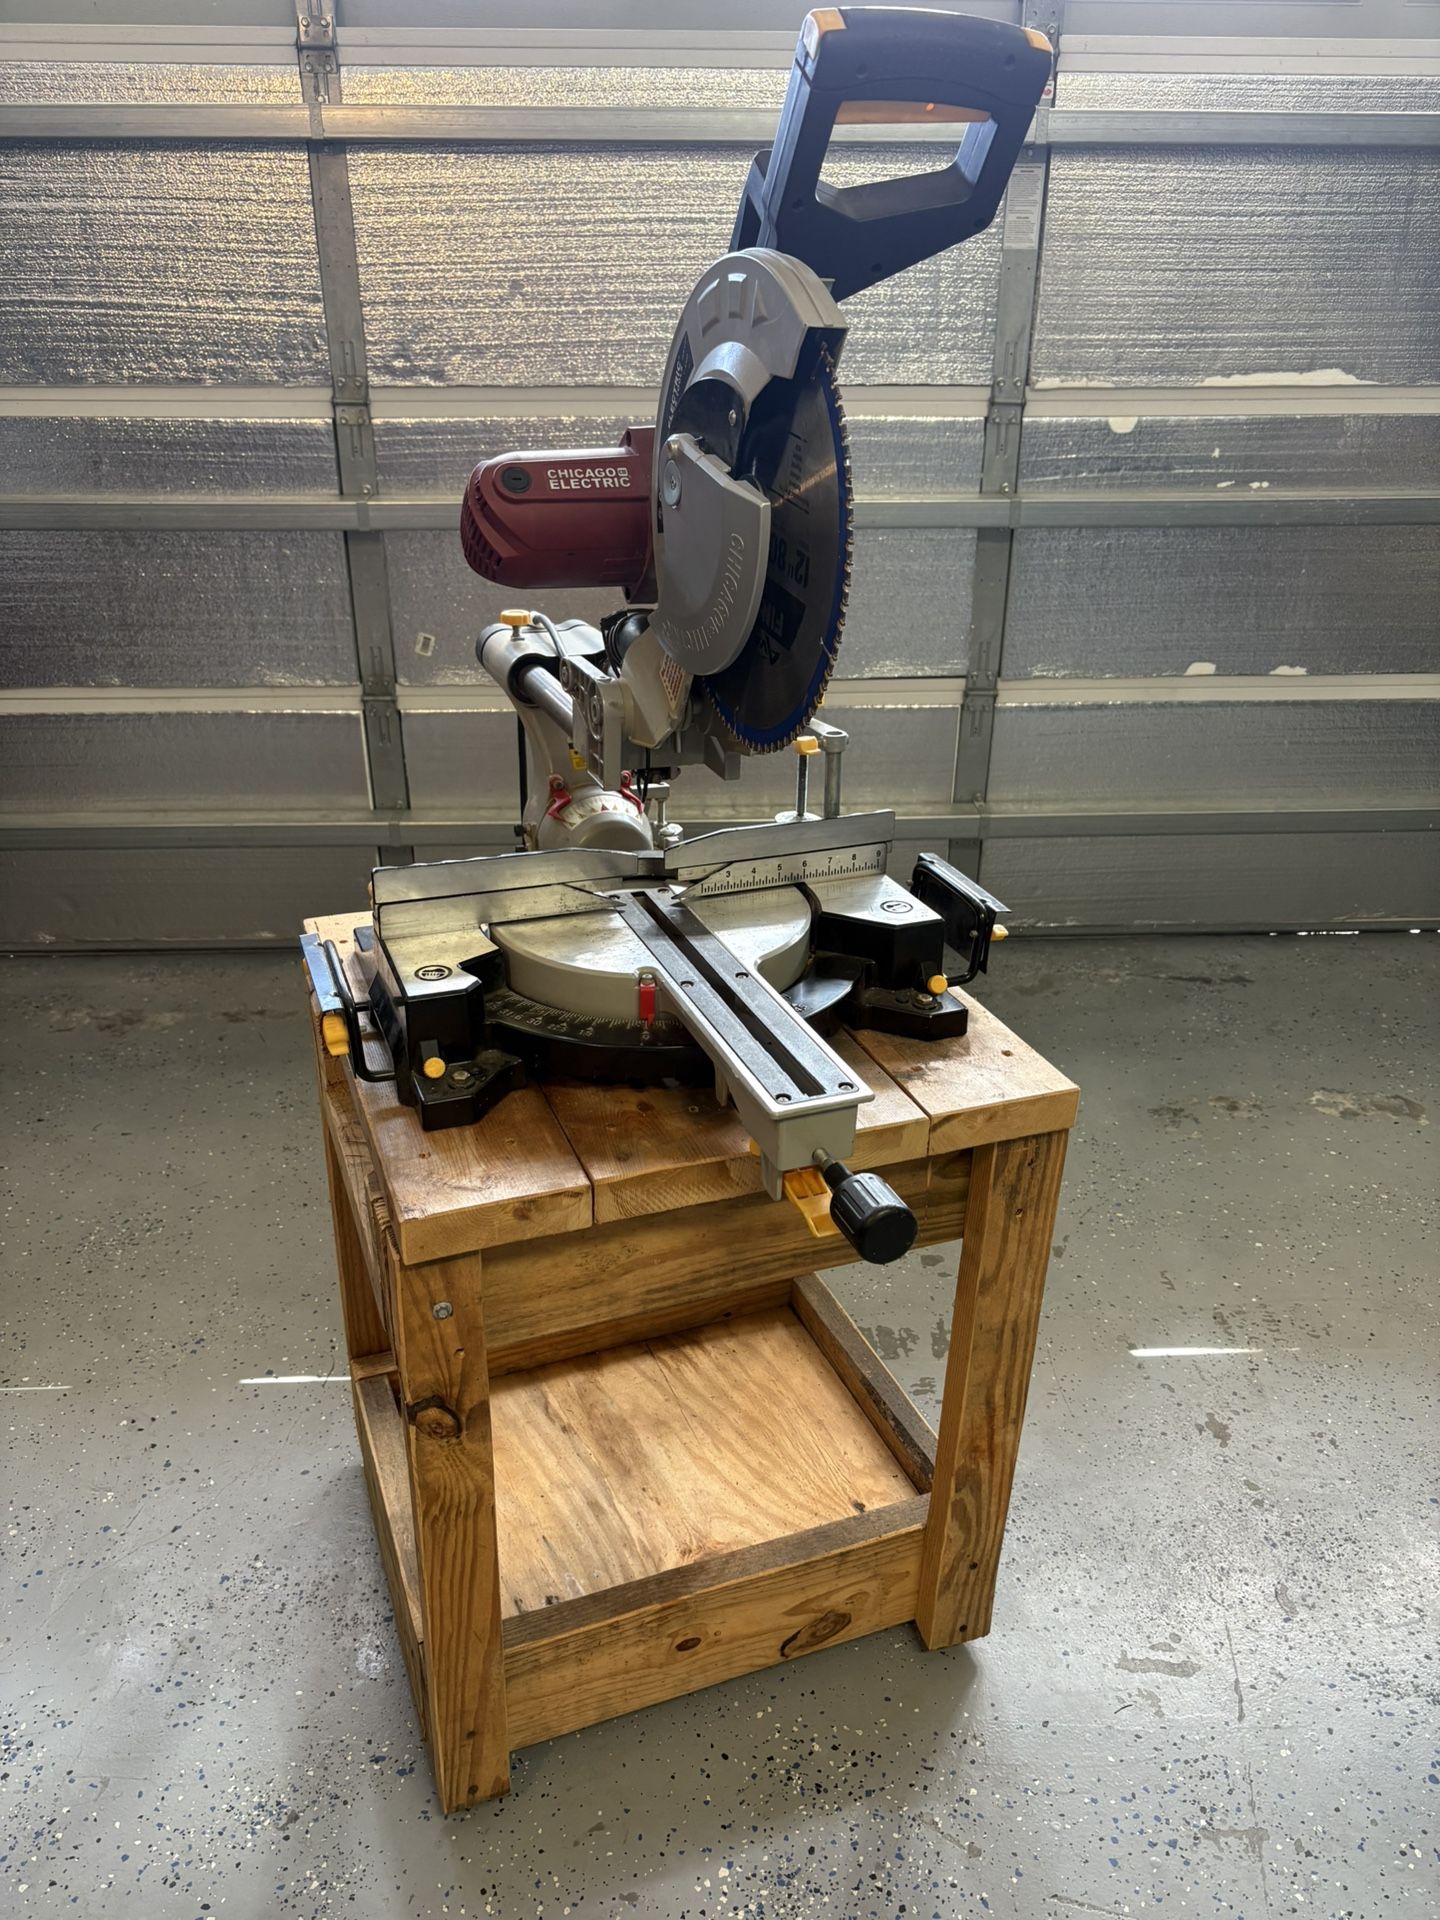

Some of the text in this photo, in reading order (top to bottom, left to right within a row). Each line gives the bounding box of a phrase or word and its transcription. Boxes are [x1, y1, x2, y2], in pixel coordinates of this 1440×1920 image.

[547, 467, 616, 479] CHICAGO
[549, 477, 631, 490] ELECTRIC
[726, 870, 731, 878] 3
[852, 853, 857, 861] 8
